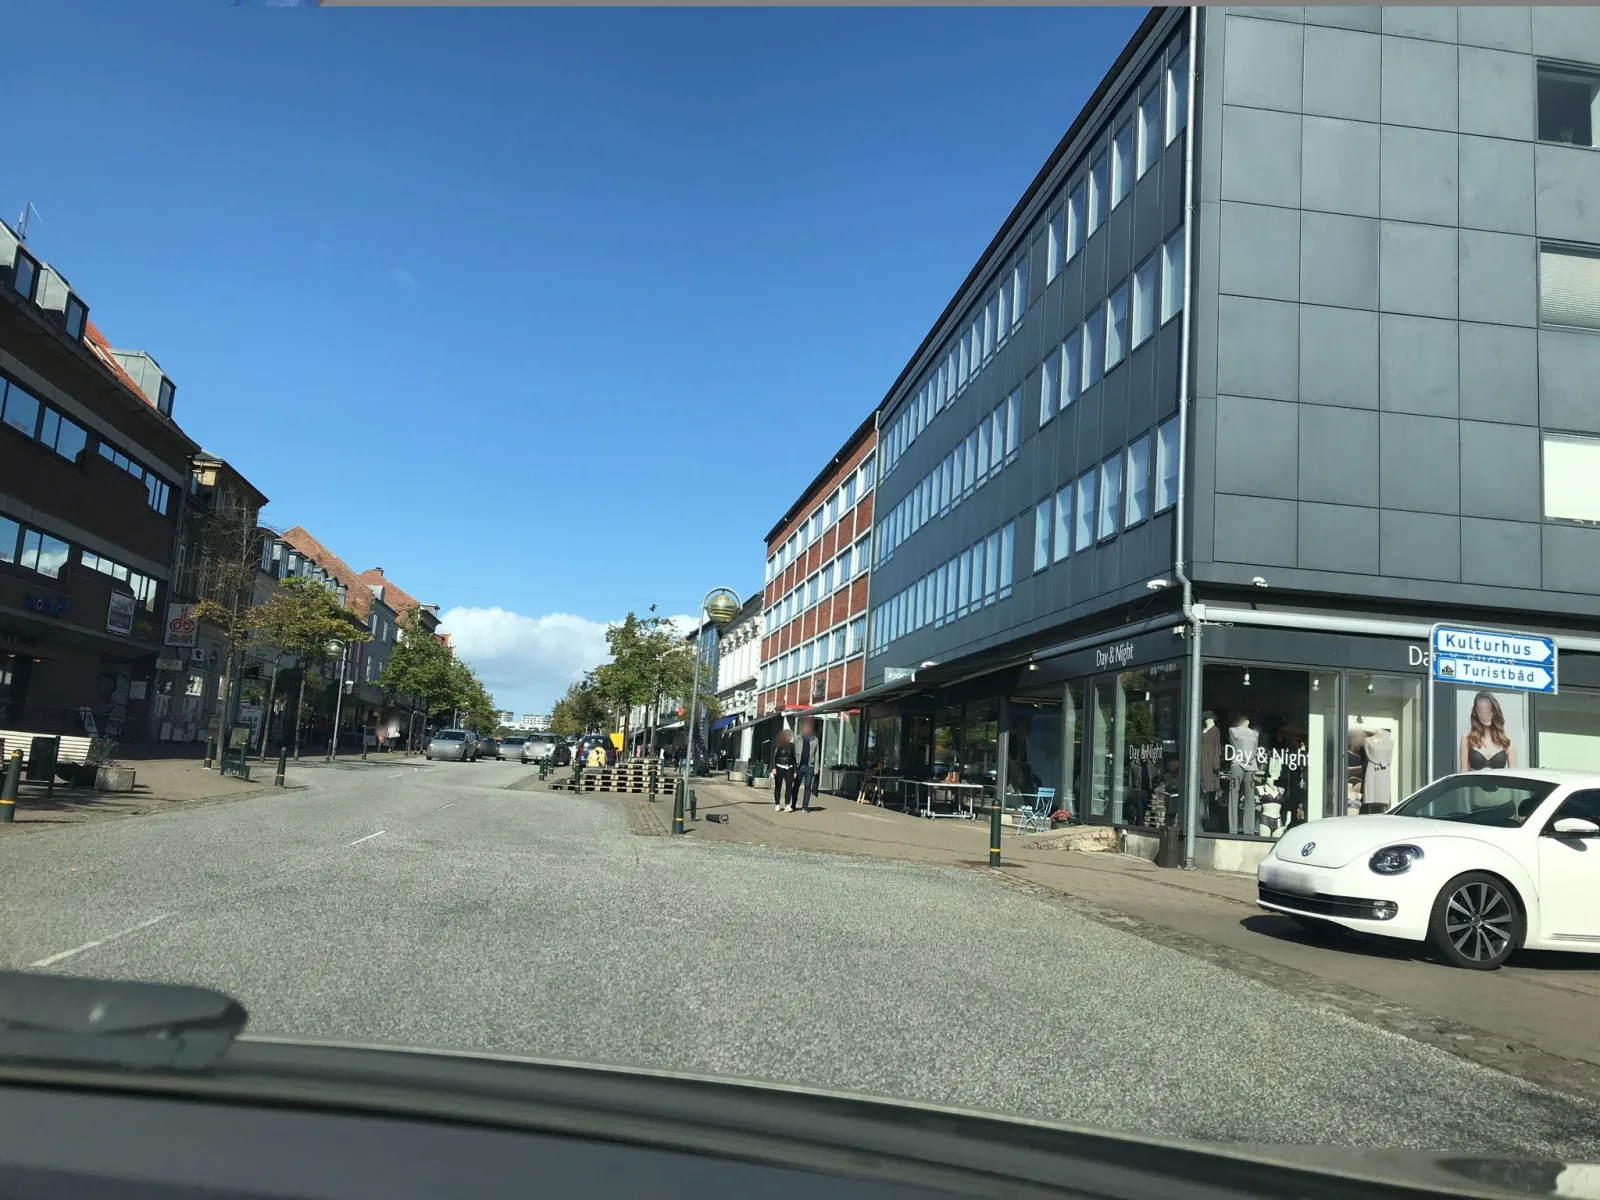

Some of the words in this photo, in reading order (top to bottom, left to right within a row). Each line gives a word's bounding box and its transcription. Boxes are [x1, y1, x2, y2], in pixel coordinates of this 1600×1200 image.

[1096, 649, 1109, 670] Day
[1109, 646, 1115, 664] &
[1115, 641, 1134, 667] Night
[1446, 633, 1532, 656] Kulturhus
[1408, 645, 1430, 667] Da
[1462, 663, 1534, 683] Turistbåd
[1129, 744, 1141, 764] Day
[1146, 742, 1163, 764] Night
[1224, 744, 1252, 768] Day
[1257, 746, 1268, 764] &
[1272, 747, 1312, 771] Night
